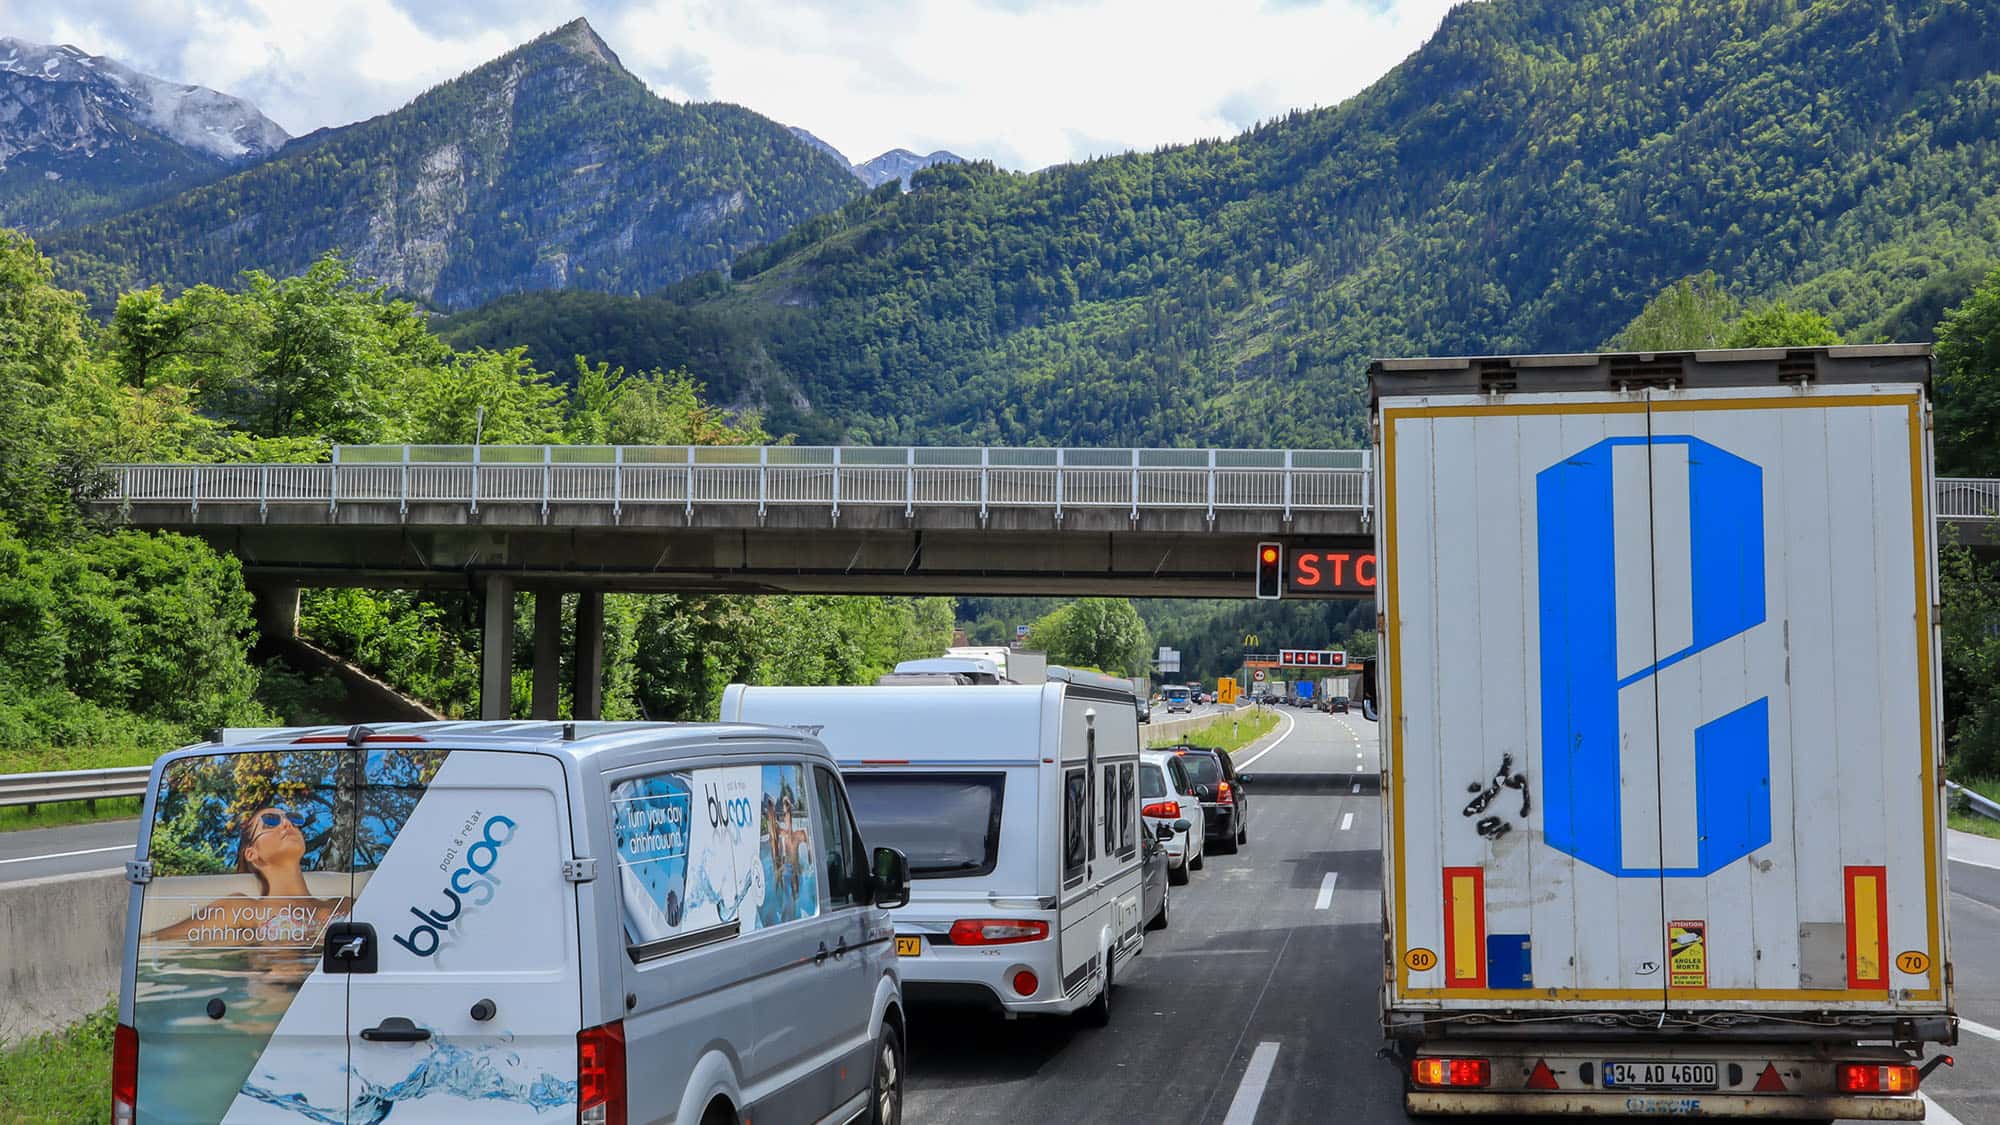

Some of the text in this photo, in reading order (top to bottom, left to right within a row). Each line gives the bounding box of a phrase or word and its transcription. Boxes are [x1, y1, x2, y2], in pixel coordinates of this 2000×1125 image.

[1297, 554, 1377, 586] STO
[626, 807, 647, 828] Turn
[647, 808, 666, 831] your
[667, 803, 683, 828] day
[440, 848, 457, 872] pool
[462, 810, 481, 836] relax
[190, 904, 318, 924] Turn your day
[898, 940, 914, 953] FV
[1412, 954, 1428, 966] 80
[1904, 956, 1921, 969] 70
[1615, 1065, 1713, 1083] 34 AD 4600
